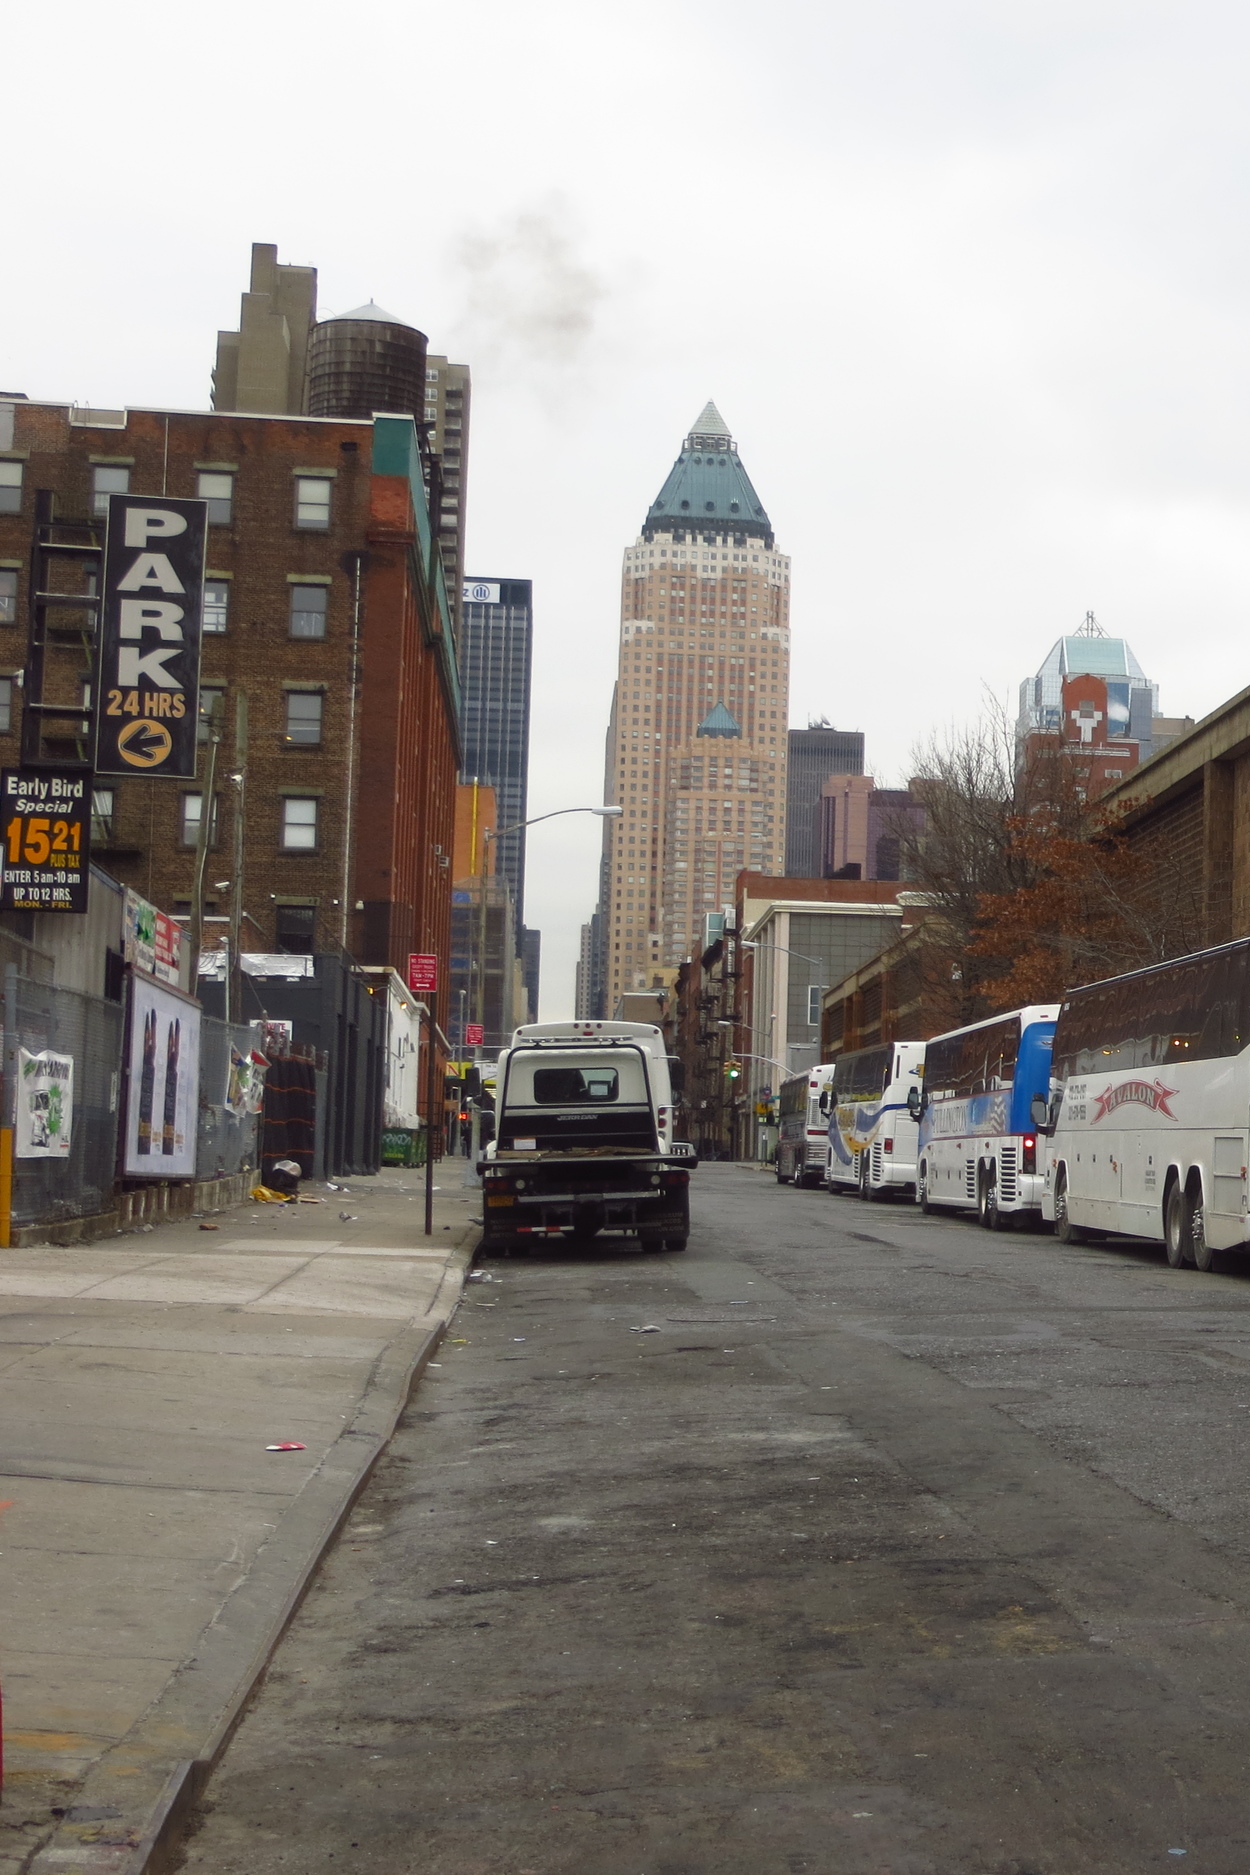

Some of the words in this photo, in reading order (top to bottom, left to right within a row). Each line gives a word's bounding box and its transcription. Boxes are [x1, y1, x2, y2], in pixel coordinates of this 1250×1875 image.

[117, 507, 188, 689] PARK
[107, 689, 140, 716] 24
[144, 691, 186, 718] HRS
[7, 776, 48, 800] Early
[52, 778, 84, 798] Bird
[15, 799, 73, 814] Special
[50, 853, 66, 868] PLUS
[67, 854, 80, 868] TAX
[4, 870, 31, 883] ENTER
[13, 887, 26, 900] UP
[28, 887, 40, 900] TO
[41, 887, 51, 900] 12
[53, 888, 72, 901] HRS.
[14, 900, 43, 908] MON.
[51, 901, 73, 909] FRI.
[1108, 1083, 1155, 1110] AVALON
